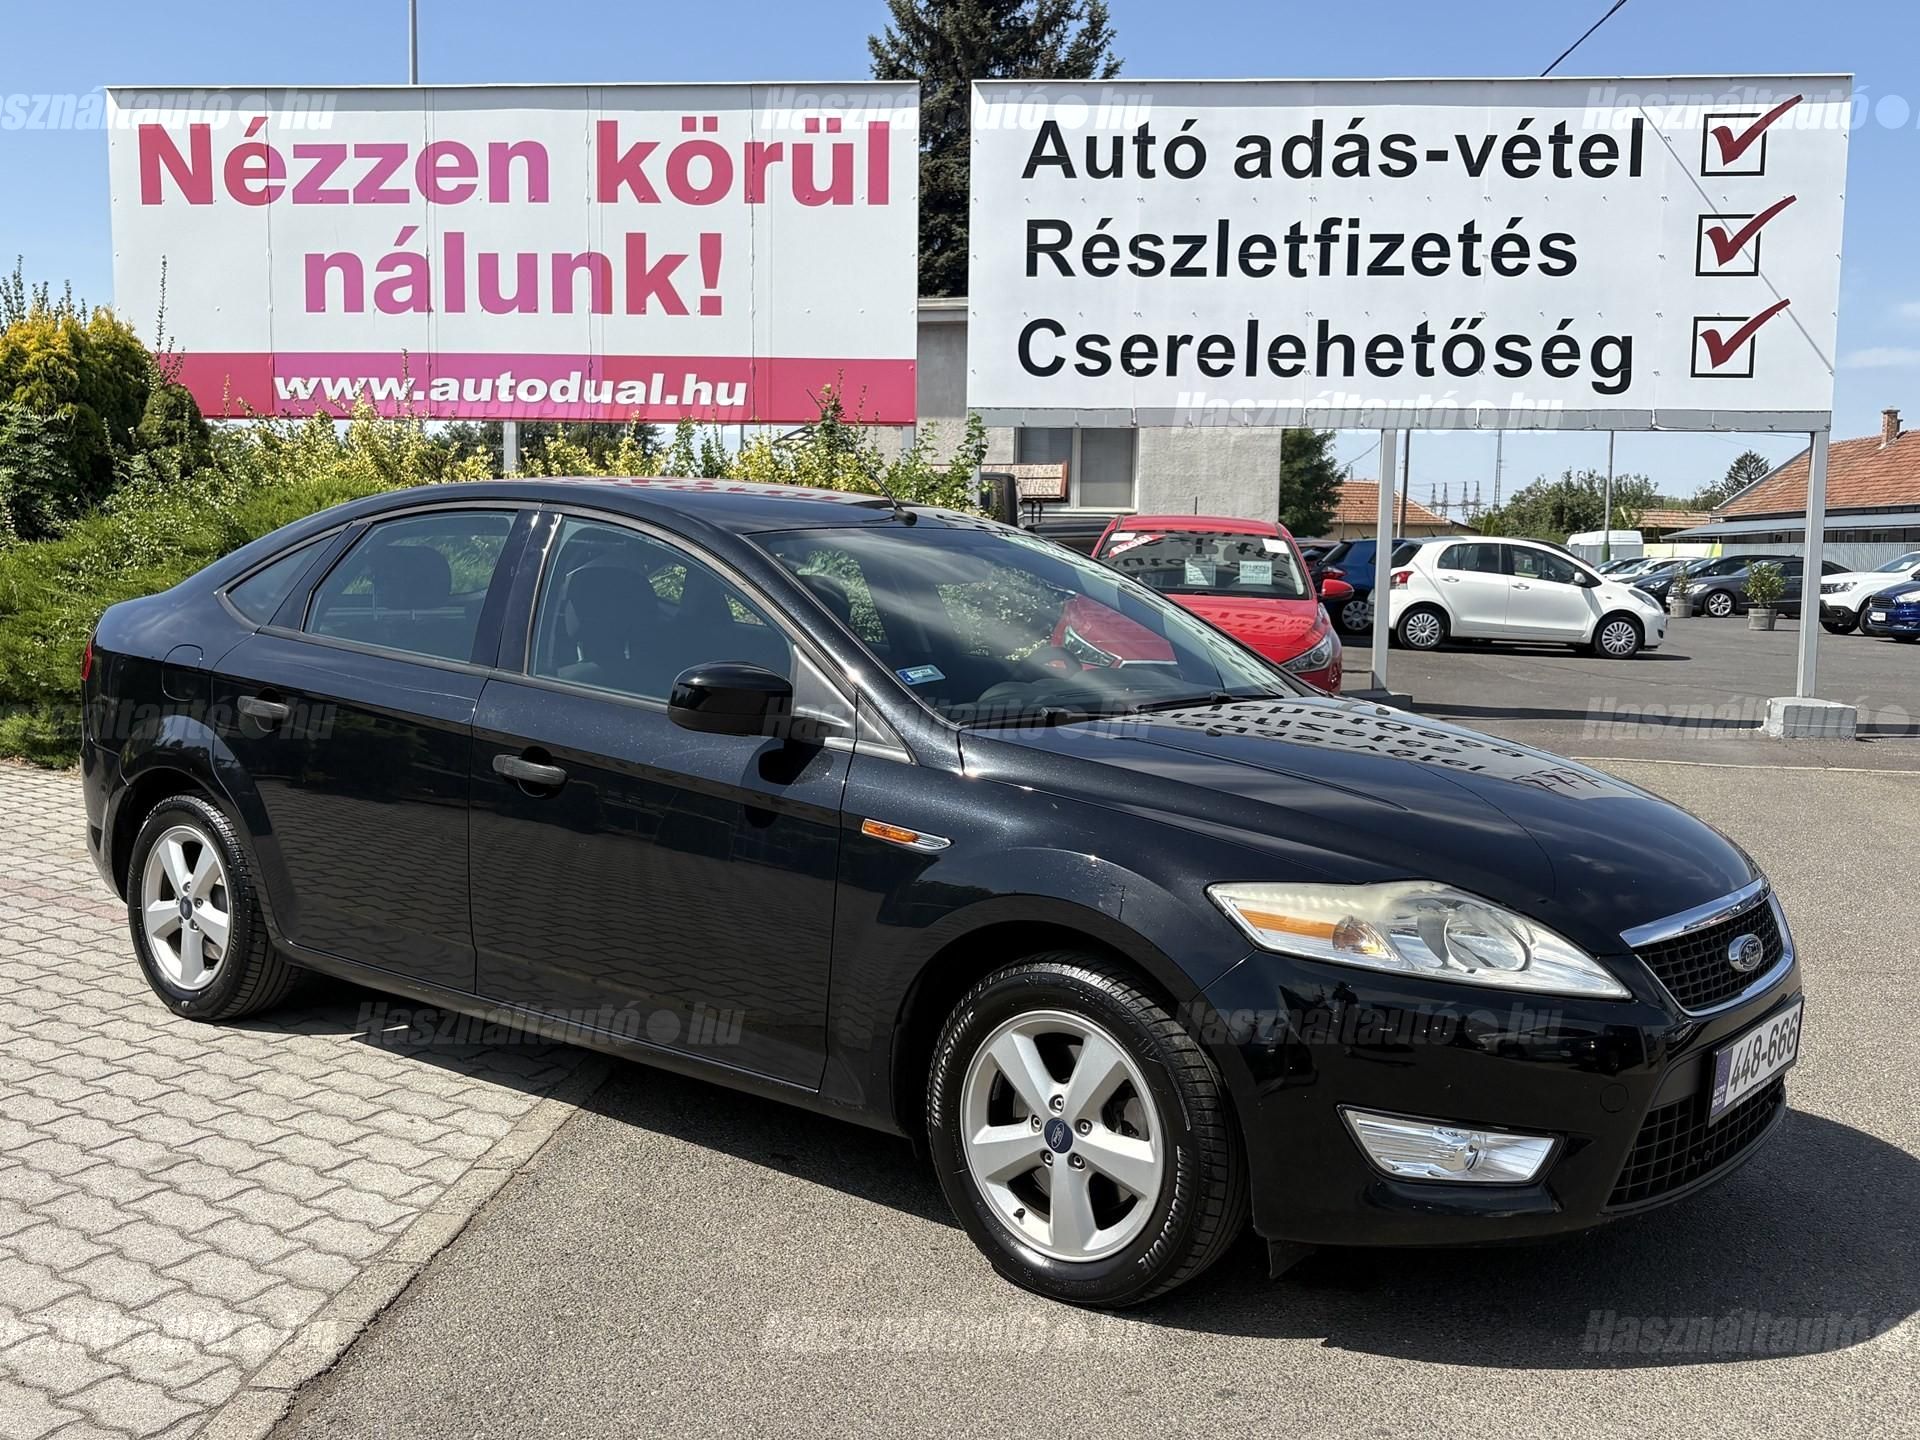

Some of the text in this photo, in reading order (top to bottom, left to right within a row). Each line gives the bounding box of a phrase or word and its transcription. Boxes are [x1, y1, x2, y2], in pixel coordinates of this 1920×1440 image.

[138, 116, 890, 207] Nézzen körül
[1021, 117, 1644, 180] Autó adás-vétel
[305, 226, 722, 316] nálunk!
[1026, 216, 1577, 278] Részletfizetés
[274, 371, 747, 406] www.autodual.hu
[1018, 317, 1634, 395] Cserelehetőség
[1730, 1012, 1798, 1093] 448-666
